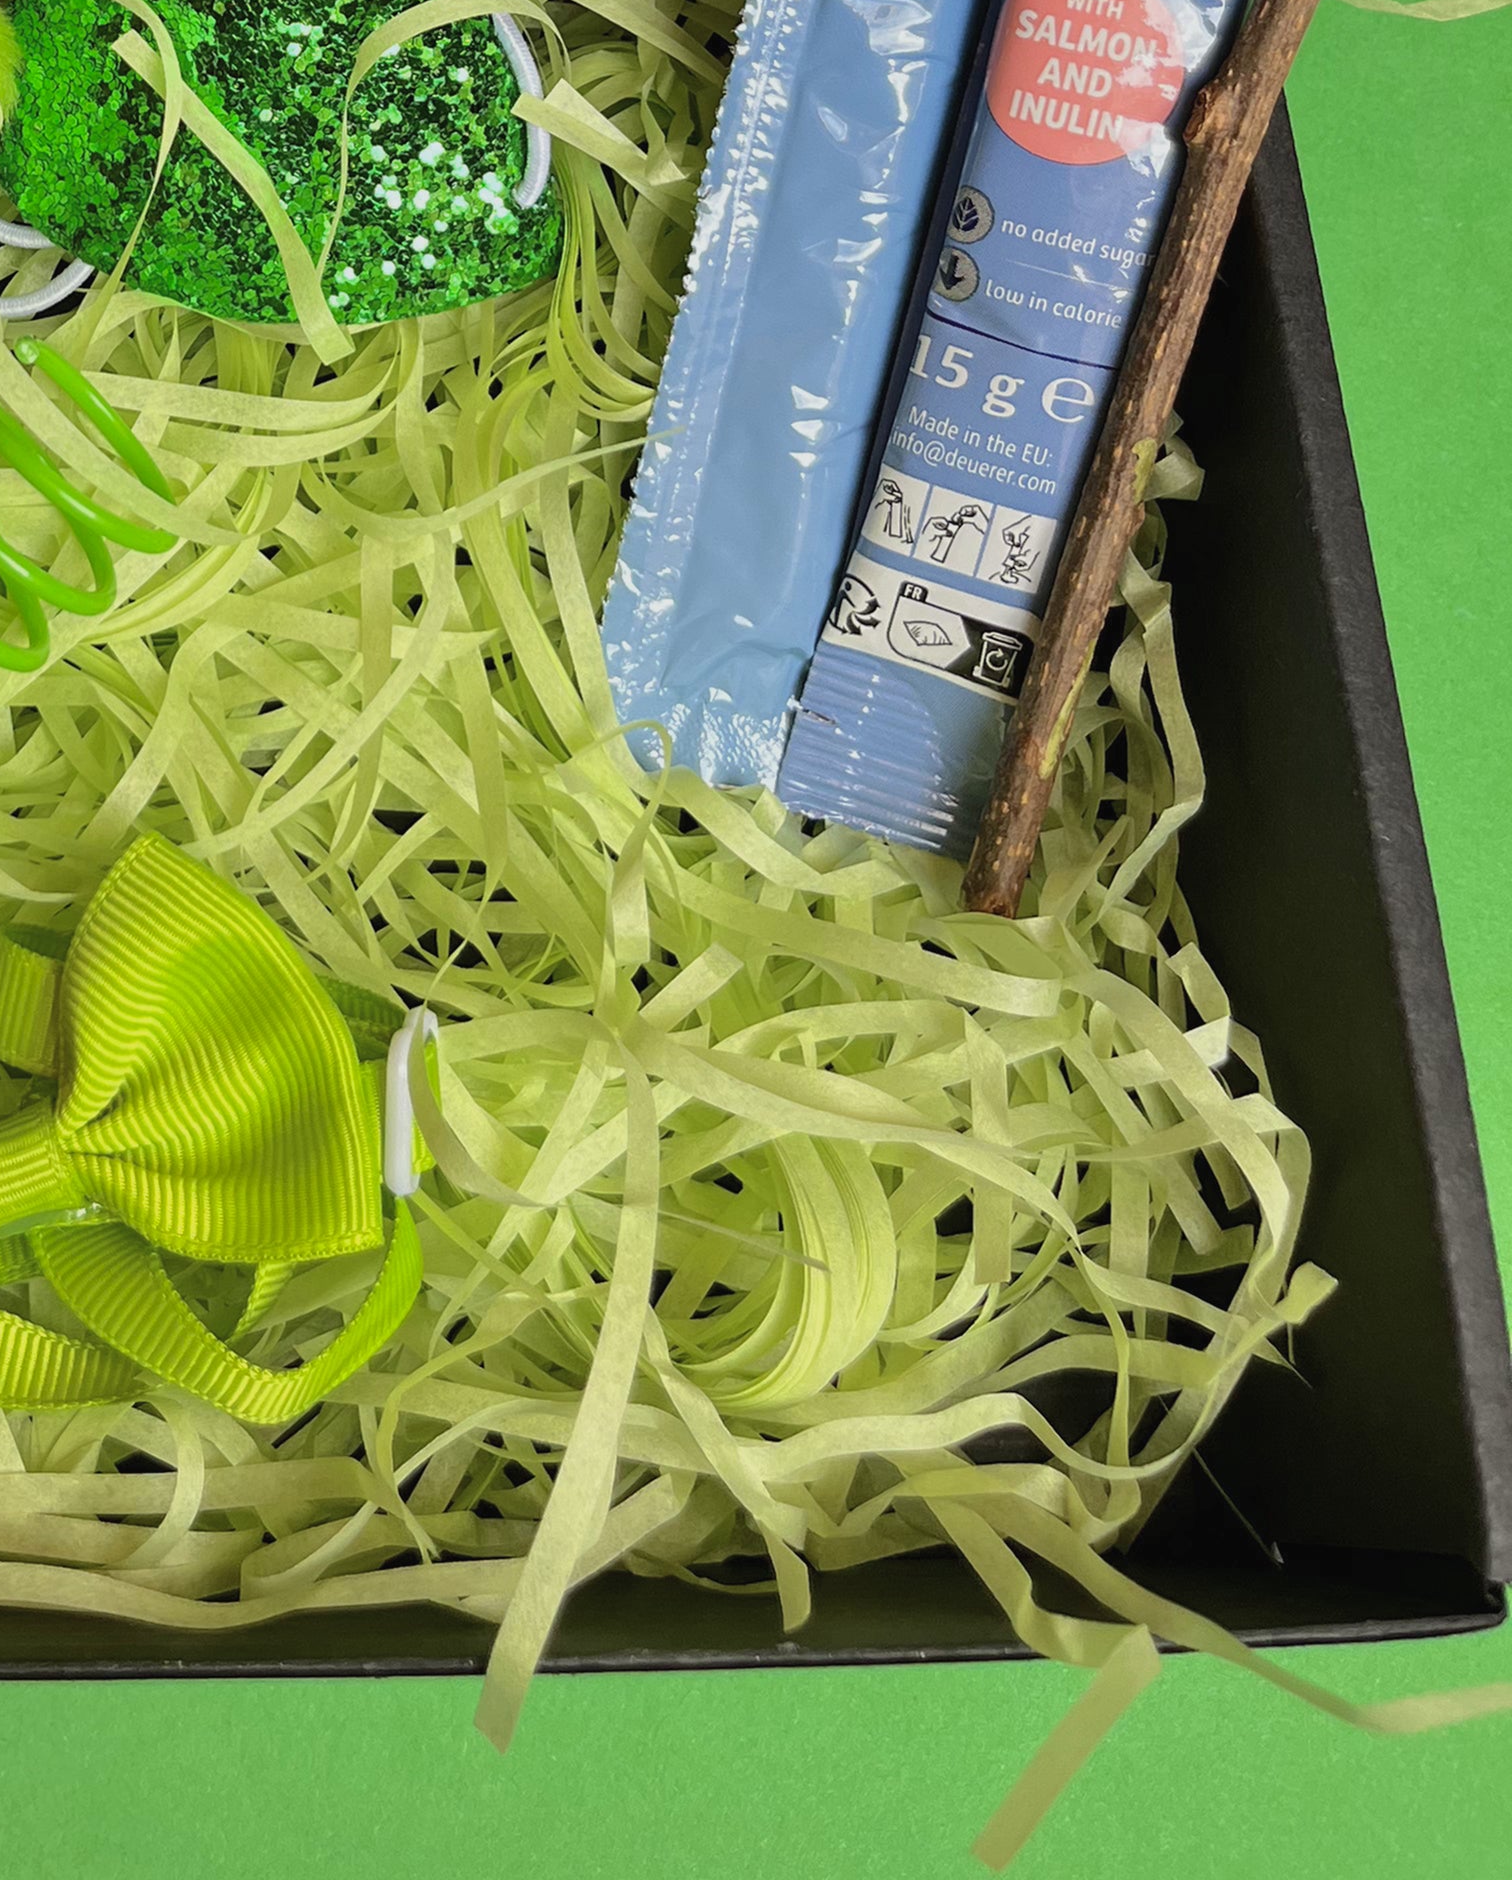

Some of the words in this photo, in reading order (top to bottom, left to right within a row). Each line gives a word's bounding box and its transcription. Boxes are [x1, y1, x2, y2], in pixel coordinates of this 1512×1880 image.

[1014, 9, 1158, 63] SALMON
[1037, 57, 1113, 99] AND
[1008, 89, 1124, 143] INULIN
[1001, 218, 1027, 239] no
[1031, 227, 1096, 256] added
[1099, 244, 1156, 269] sugar
[986, 279, 1024, 305] low
[1028, 291, 1048, 312] in
[908, 334, 974, 389] 15
[982, 374, 1026, 418] g
[891, 426, 1057, 496] info@deuerer.com
[907, 405, 959, 440] Made
[963, 424, 981, 447] in
[986, 433, 1017, 459] the
[1021, 442, 1054, 469] EU:
[903, 583, 923, 601] FR
